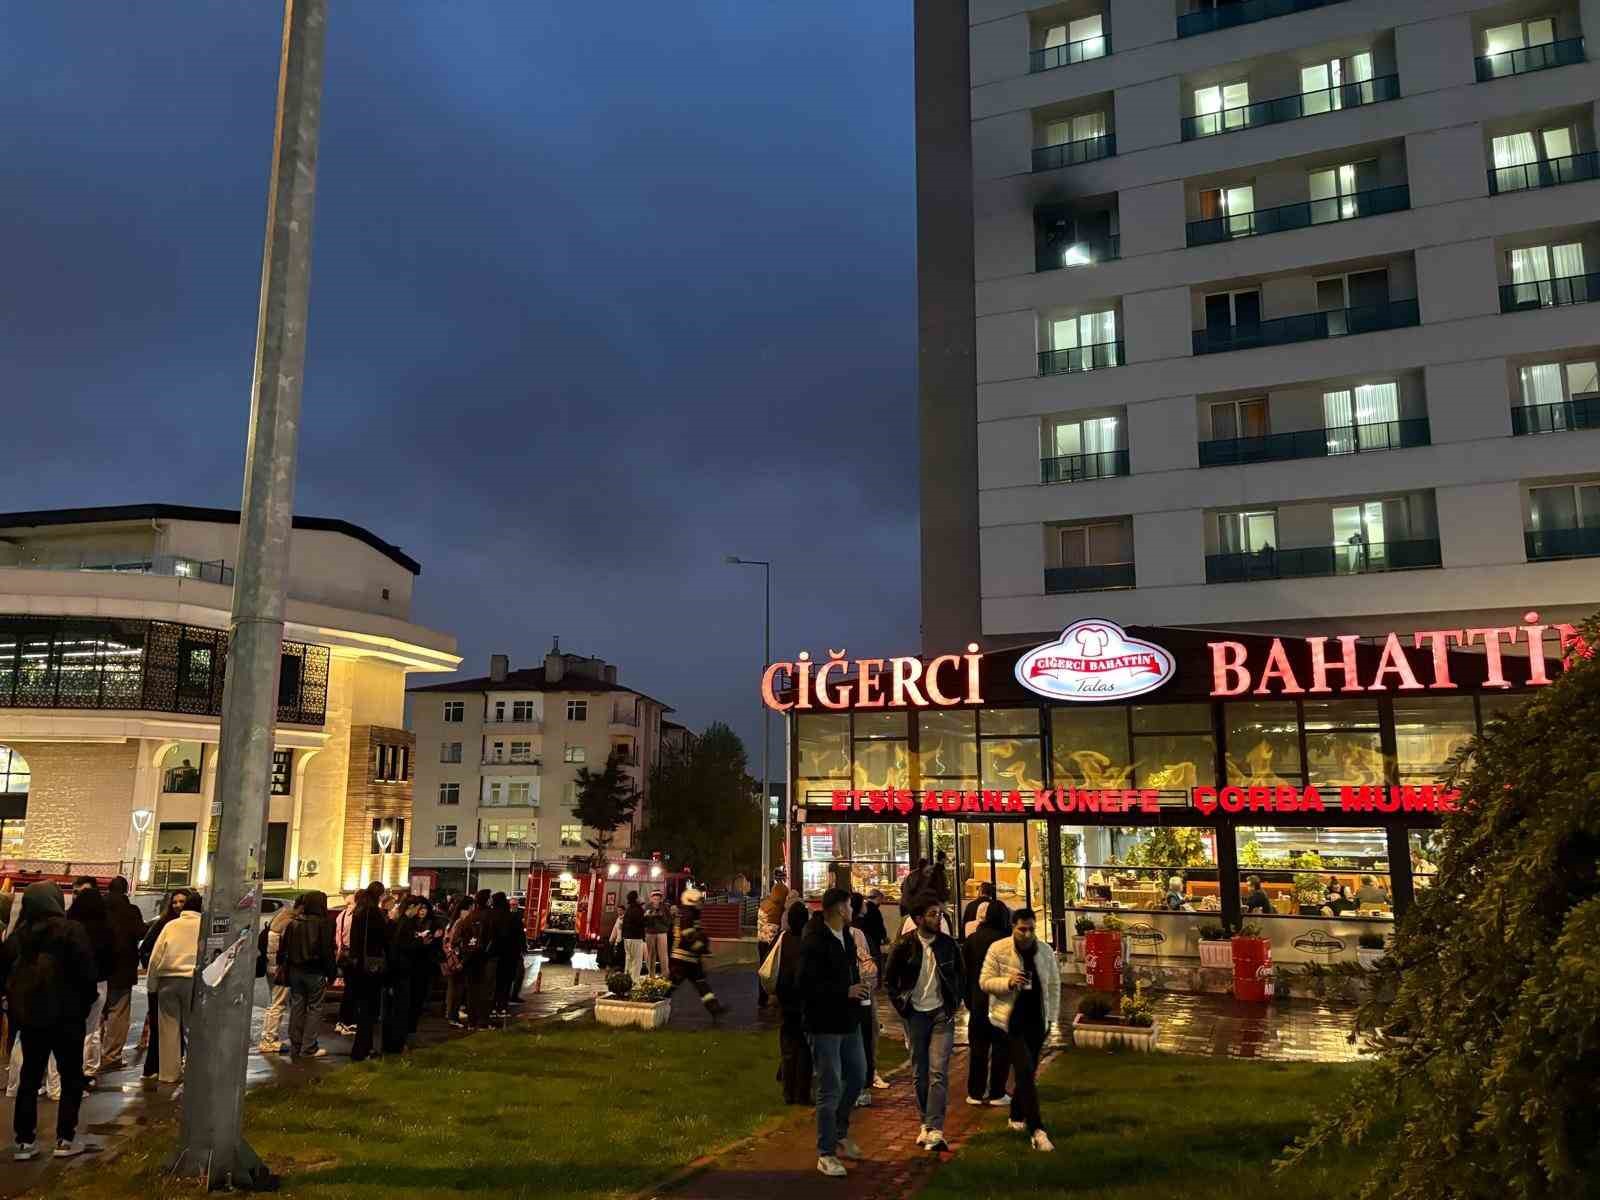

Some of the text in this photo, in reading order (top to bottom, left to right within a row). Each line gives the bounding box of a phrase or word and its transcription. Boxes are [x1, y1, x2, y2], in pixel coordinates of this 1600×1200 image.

[761, 643, 984, 712] CİĞERCİ
[1075, 676, 1115, 692] Talas
[921, 788, 1025, 813] ADANA
[1034, 784, 1161, 813] KÜNEFE
[1192, 785, 1325, 816] ÇORBA
